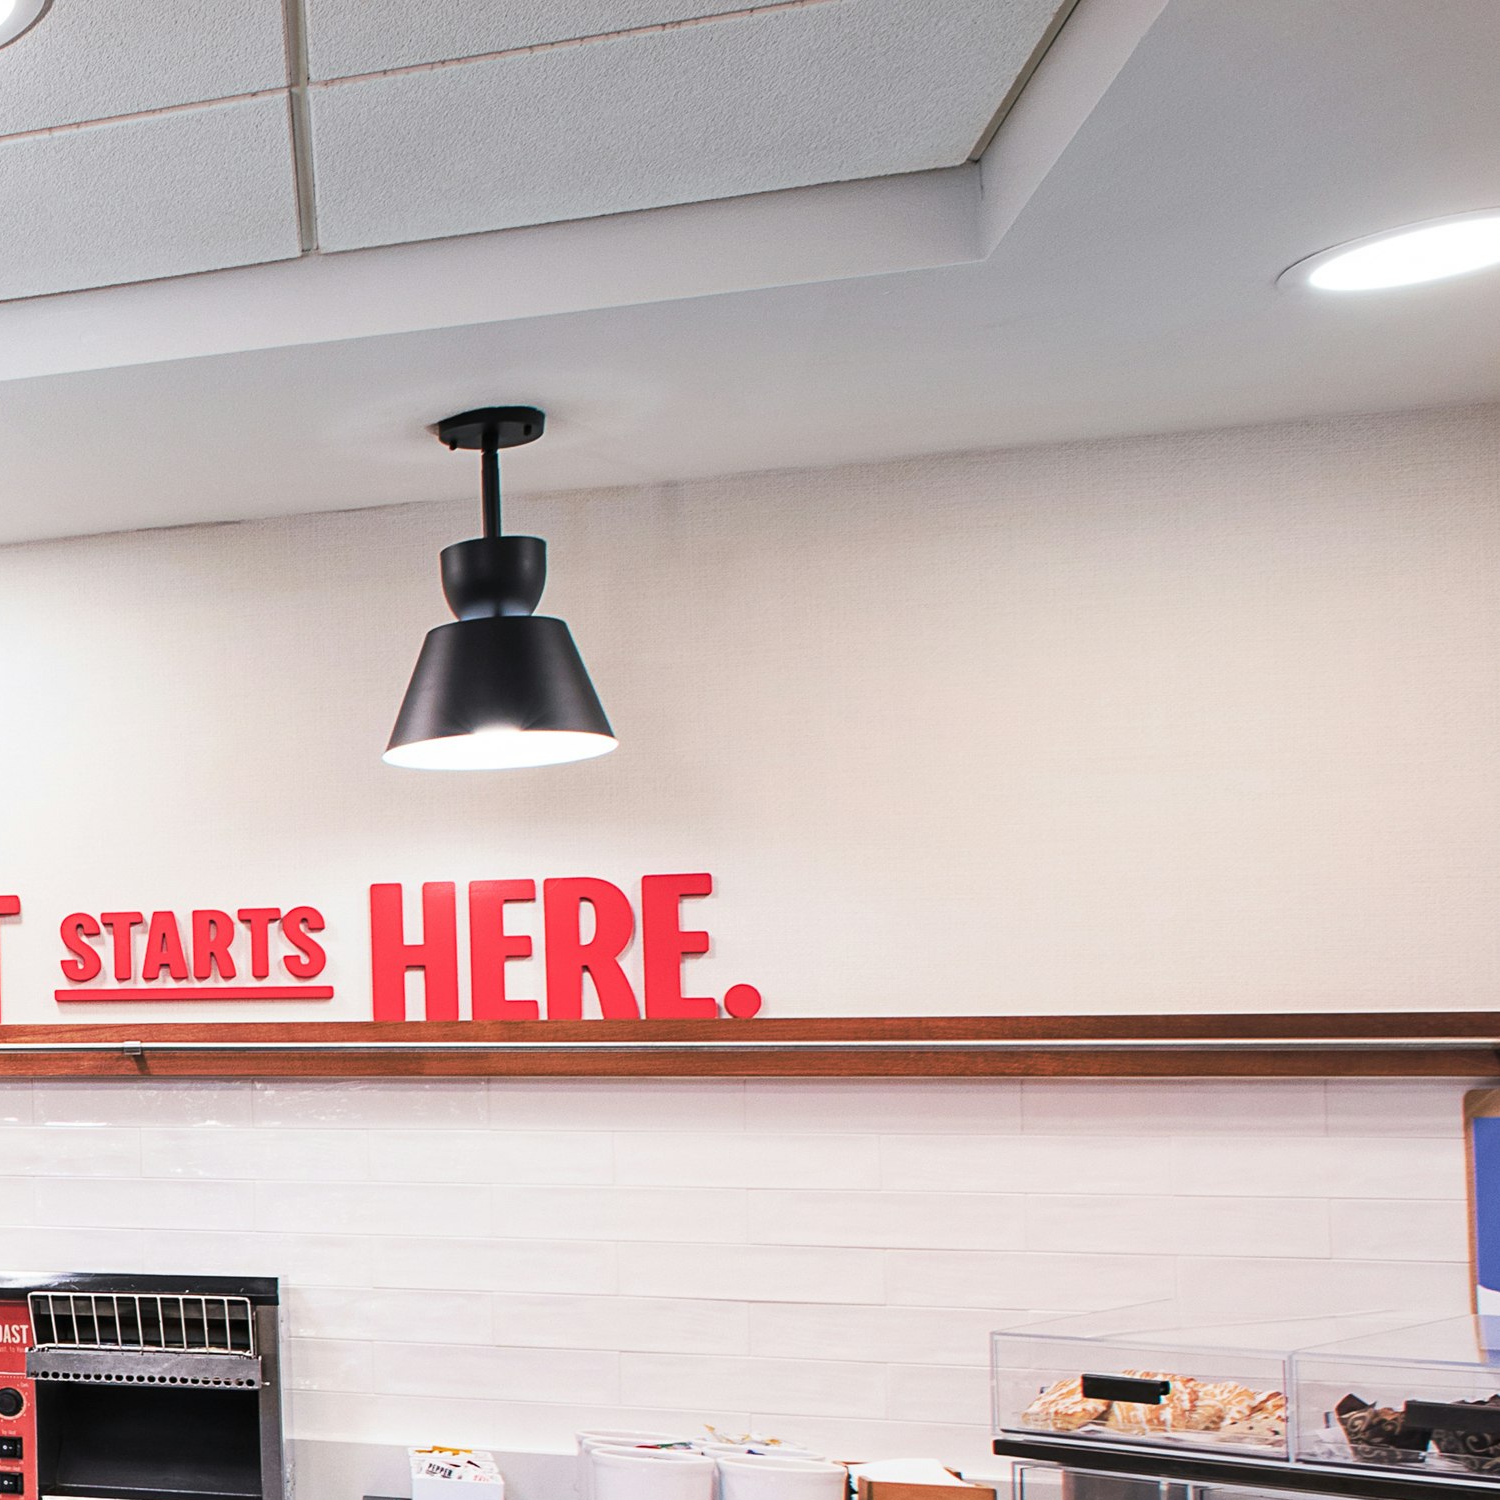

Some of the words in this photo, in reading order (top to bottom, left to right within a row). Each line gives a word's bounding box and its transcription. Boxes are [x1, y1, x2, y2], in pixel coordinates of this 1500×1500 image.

[59, 905, 327, 983] STARTS
[369, 872, 762, 1021] HERE.
[427, 1462, 453, 1477] PEPPER
